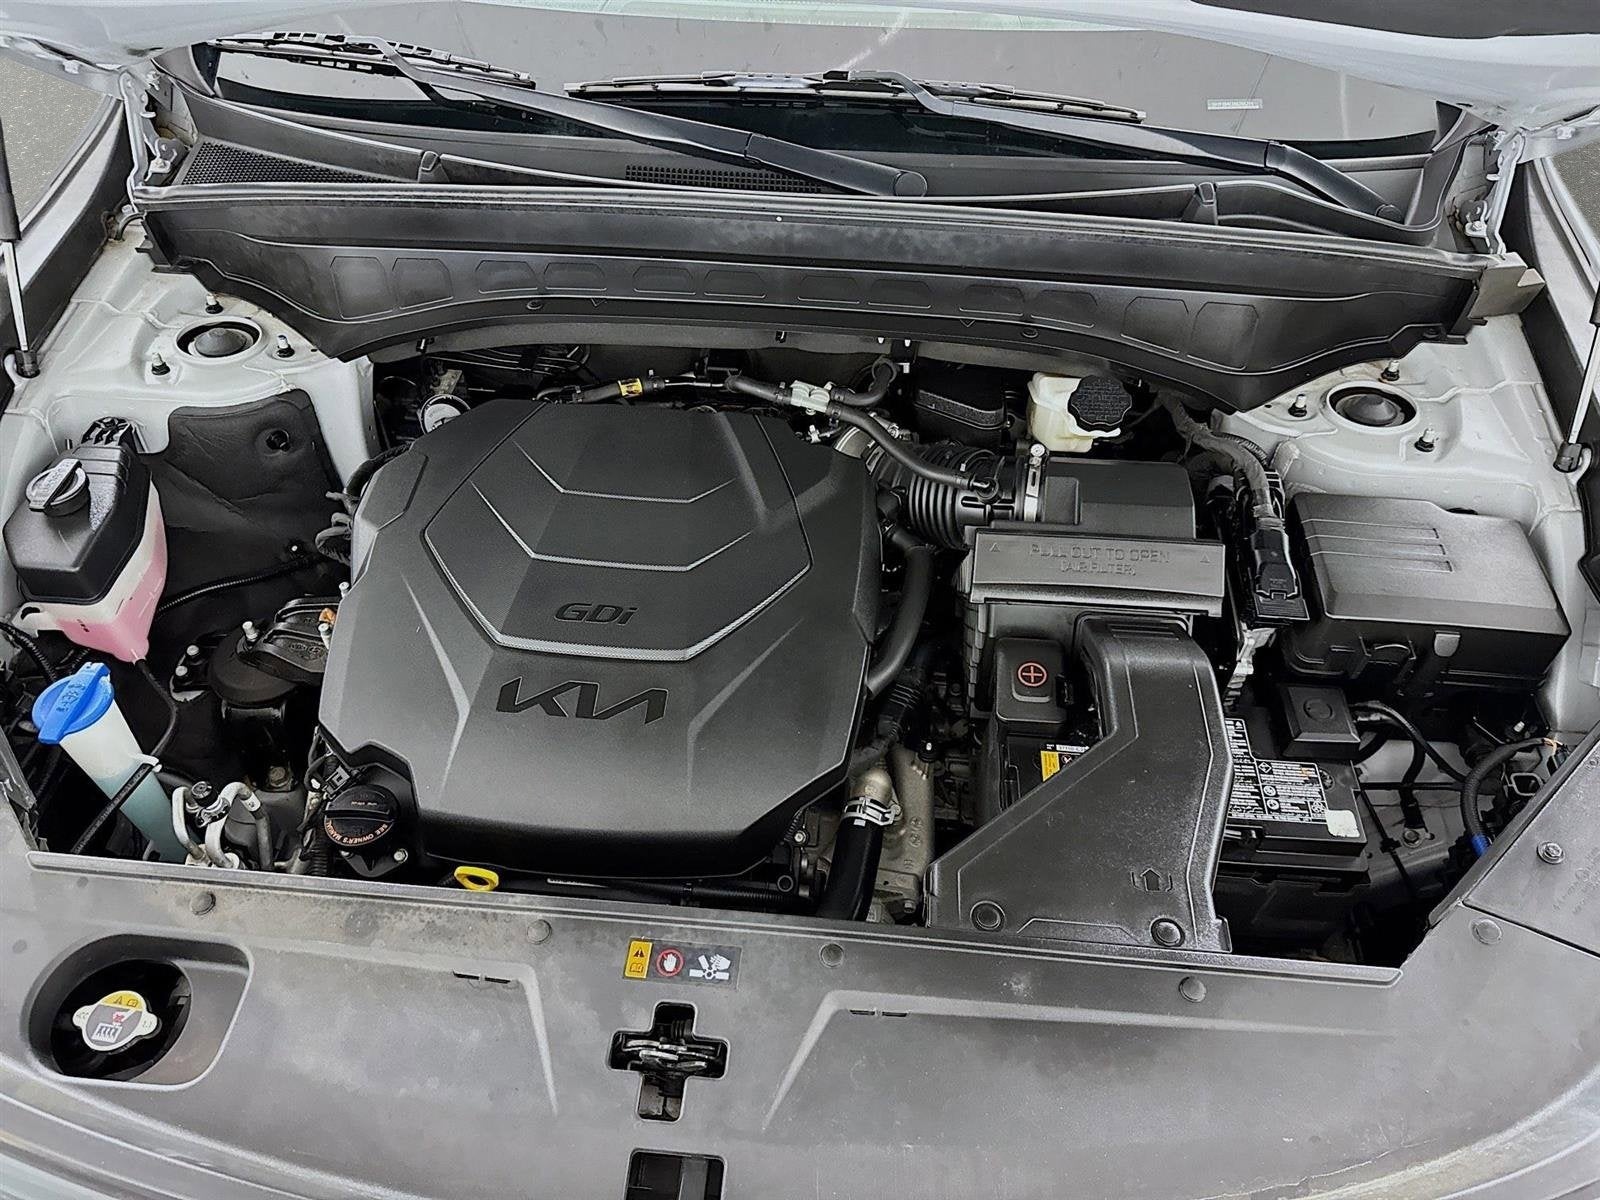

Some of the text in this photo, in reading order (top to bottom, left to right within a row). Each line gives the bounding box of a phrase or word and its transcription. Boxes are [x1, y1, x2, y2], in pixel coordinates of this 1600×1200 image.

[1071, 545, 1101, 560] OUT
[1105, 547, 1125, 561] TO
[1129, 548, 1170, 564] OPEN
[554, 603, 638, 626] GDi
[496, 677, 668, 725] KIA
[343, 834, 374, 844] OWNER'S
[375, 824, 388, 835] SEE
